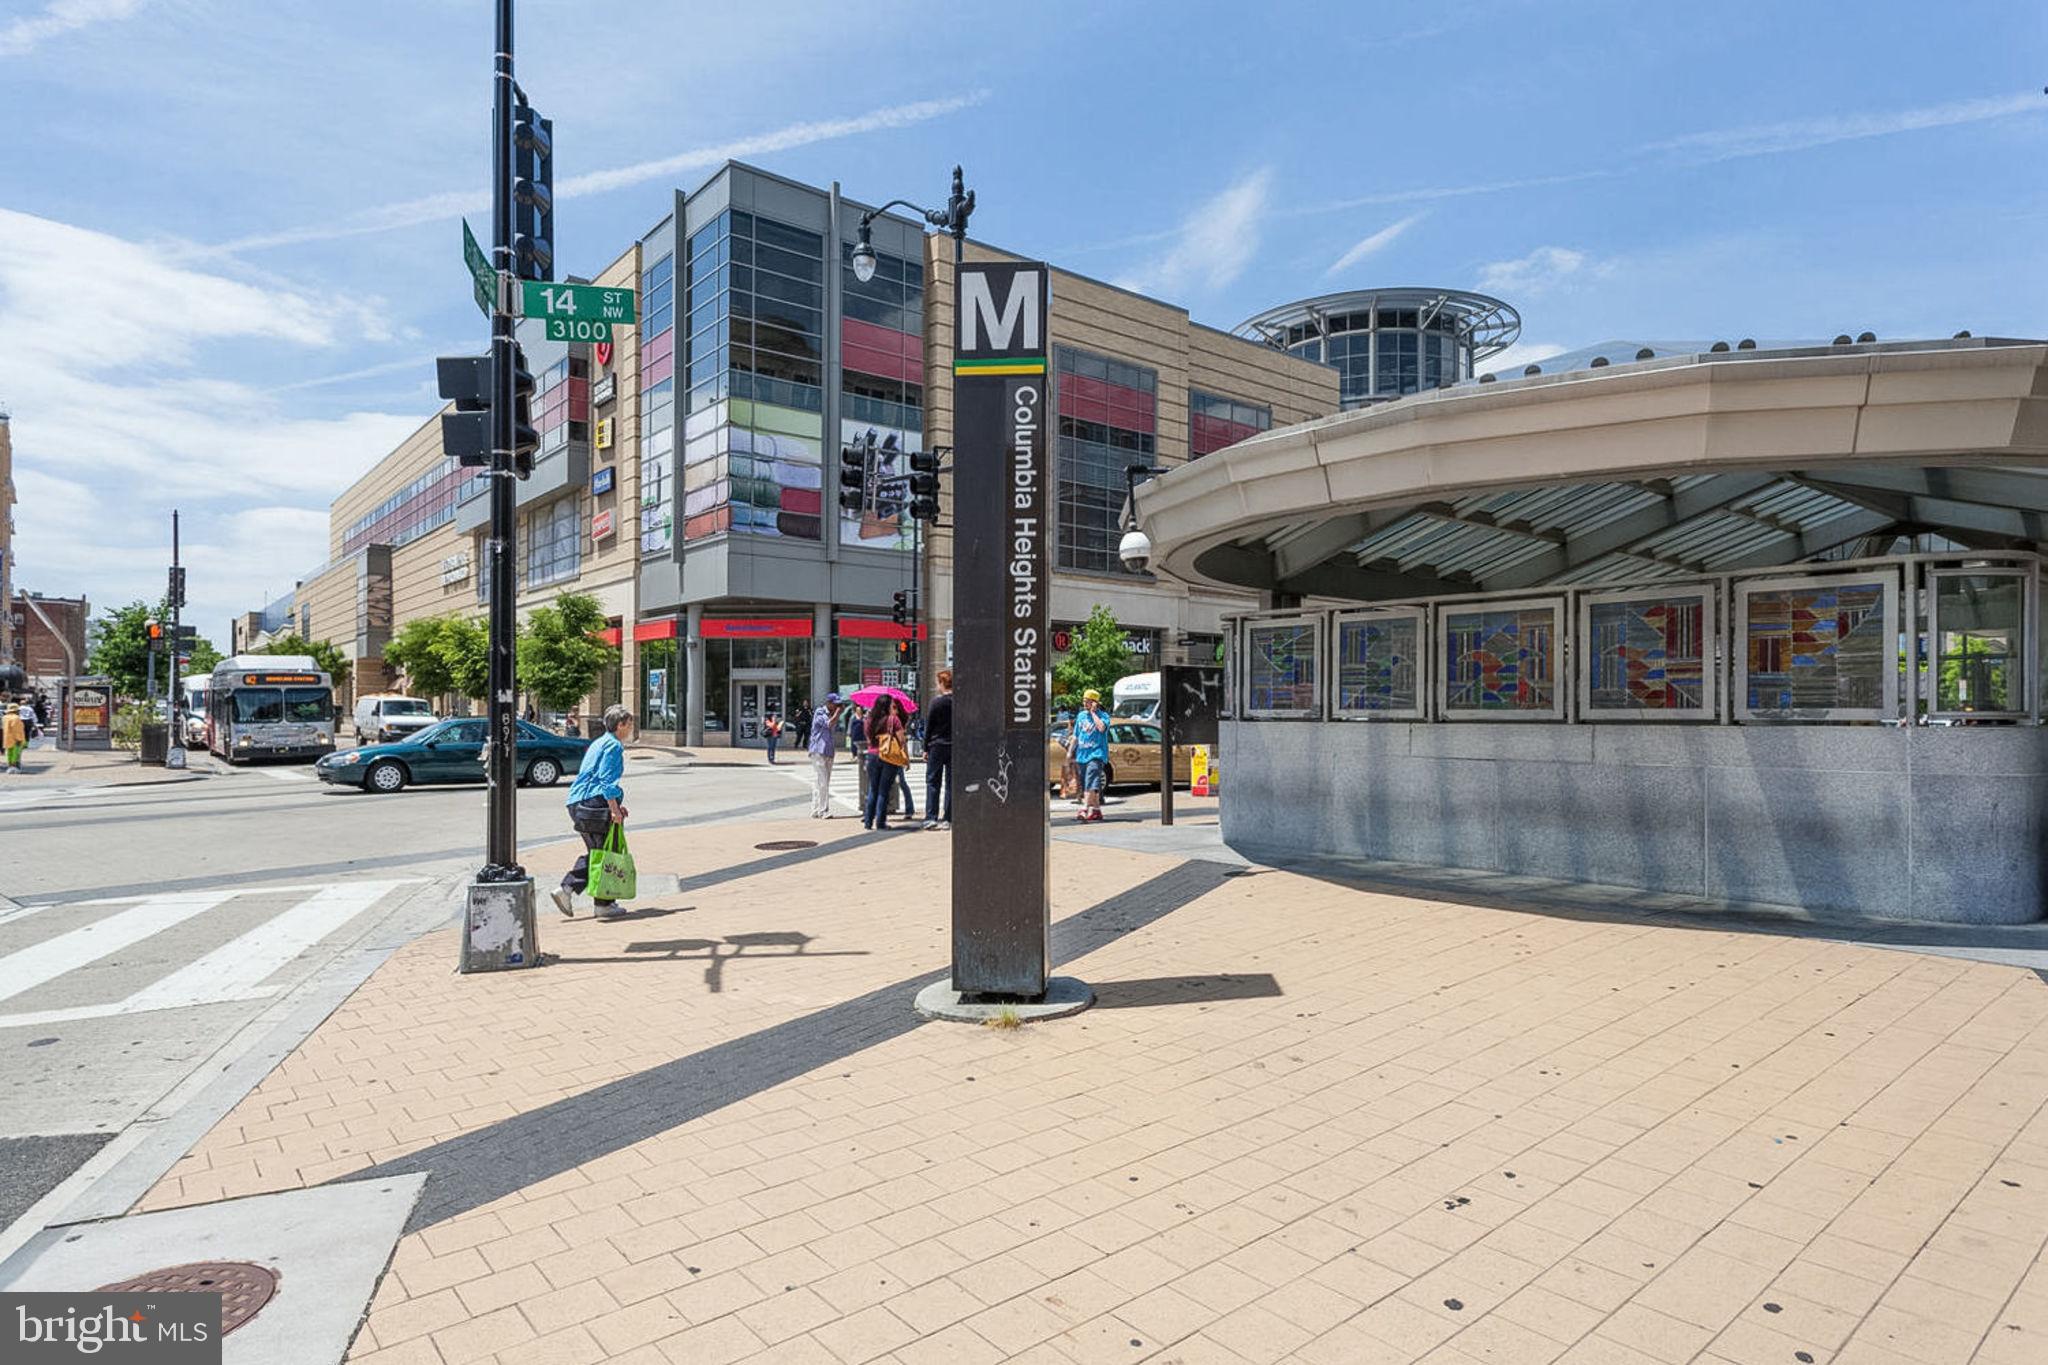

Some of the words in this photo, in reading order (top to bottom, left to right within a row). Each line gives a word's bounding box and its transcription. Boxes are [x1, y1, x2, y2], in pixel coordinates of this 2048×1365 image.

[540, 288, 577, 315] 14
[603, 292, 623, 304] ST
[603, 307, 624, 319] NW
[961, 270, 1039, 351] M
[553, 321, 607, 340] 3100
[1014, 386, 1038, 509] Columbia
[1009, 519, 1037, 618] Heights
[1014, 628, 1037, 723] Station
